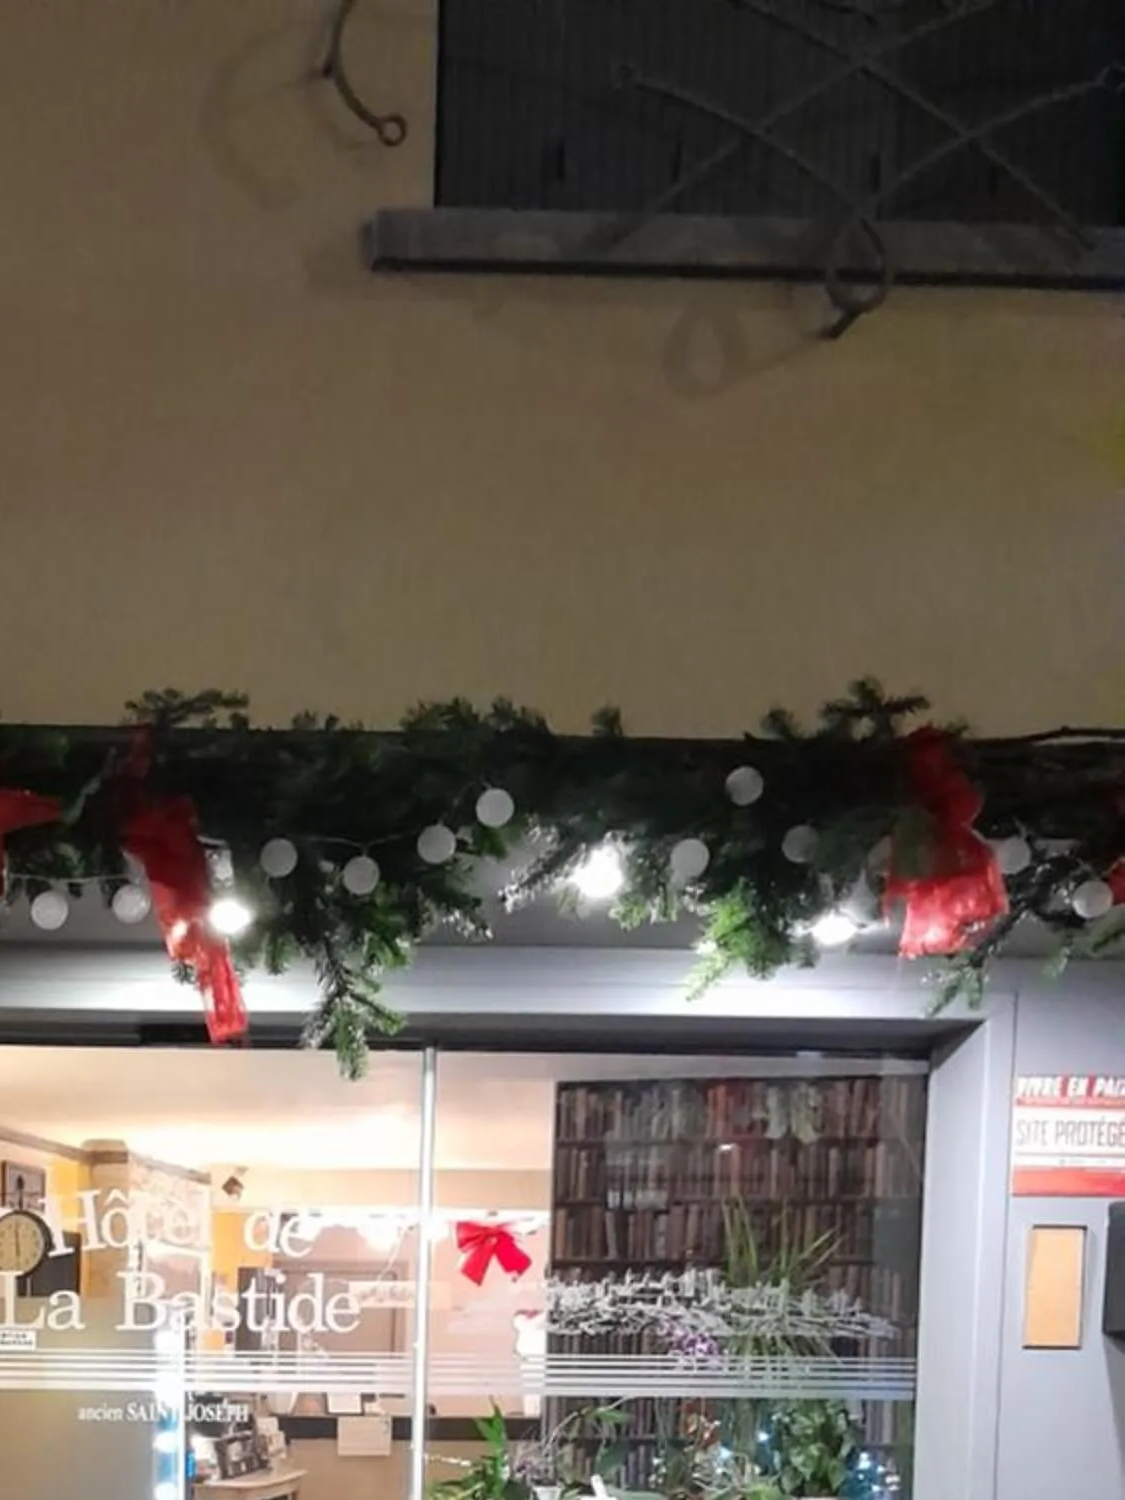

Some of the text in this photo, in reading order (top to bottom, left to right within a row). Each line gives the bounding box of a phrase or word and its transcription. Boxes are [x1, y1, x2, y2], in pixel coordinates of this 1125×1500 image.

[1016, 1119, 1049, 1147] SITE
[38, 1187, 314, 1258] Hôtel de
[115, 1270, 362, 1334] Bastide
[77, 1403, 125, 1422] ancien
